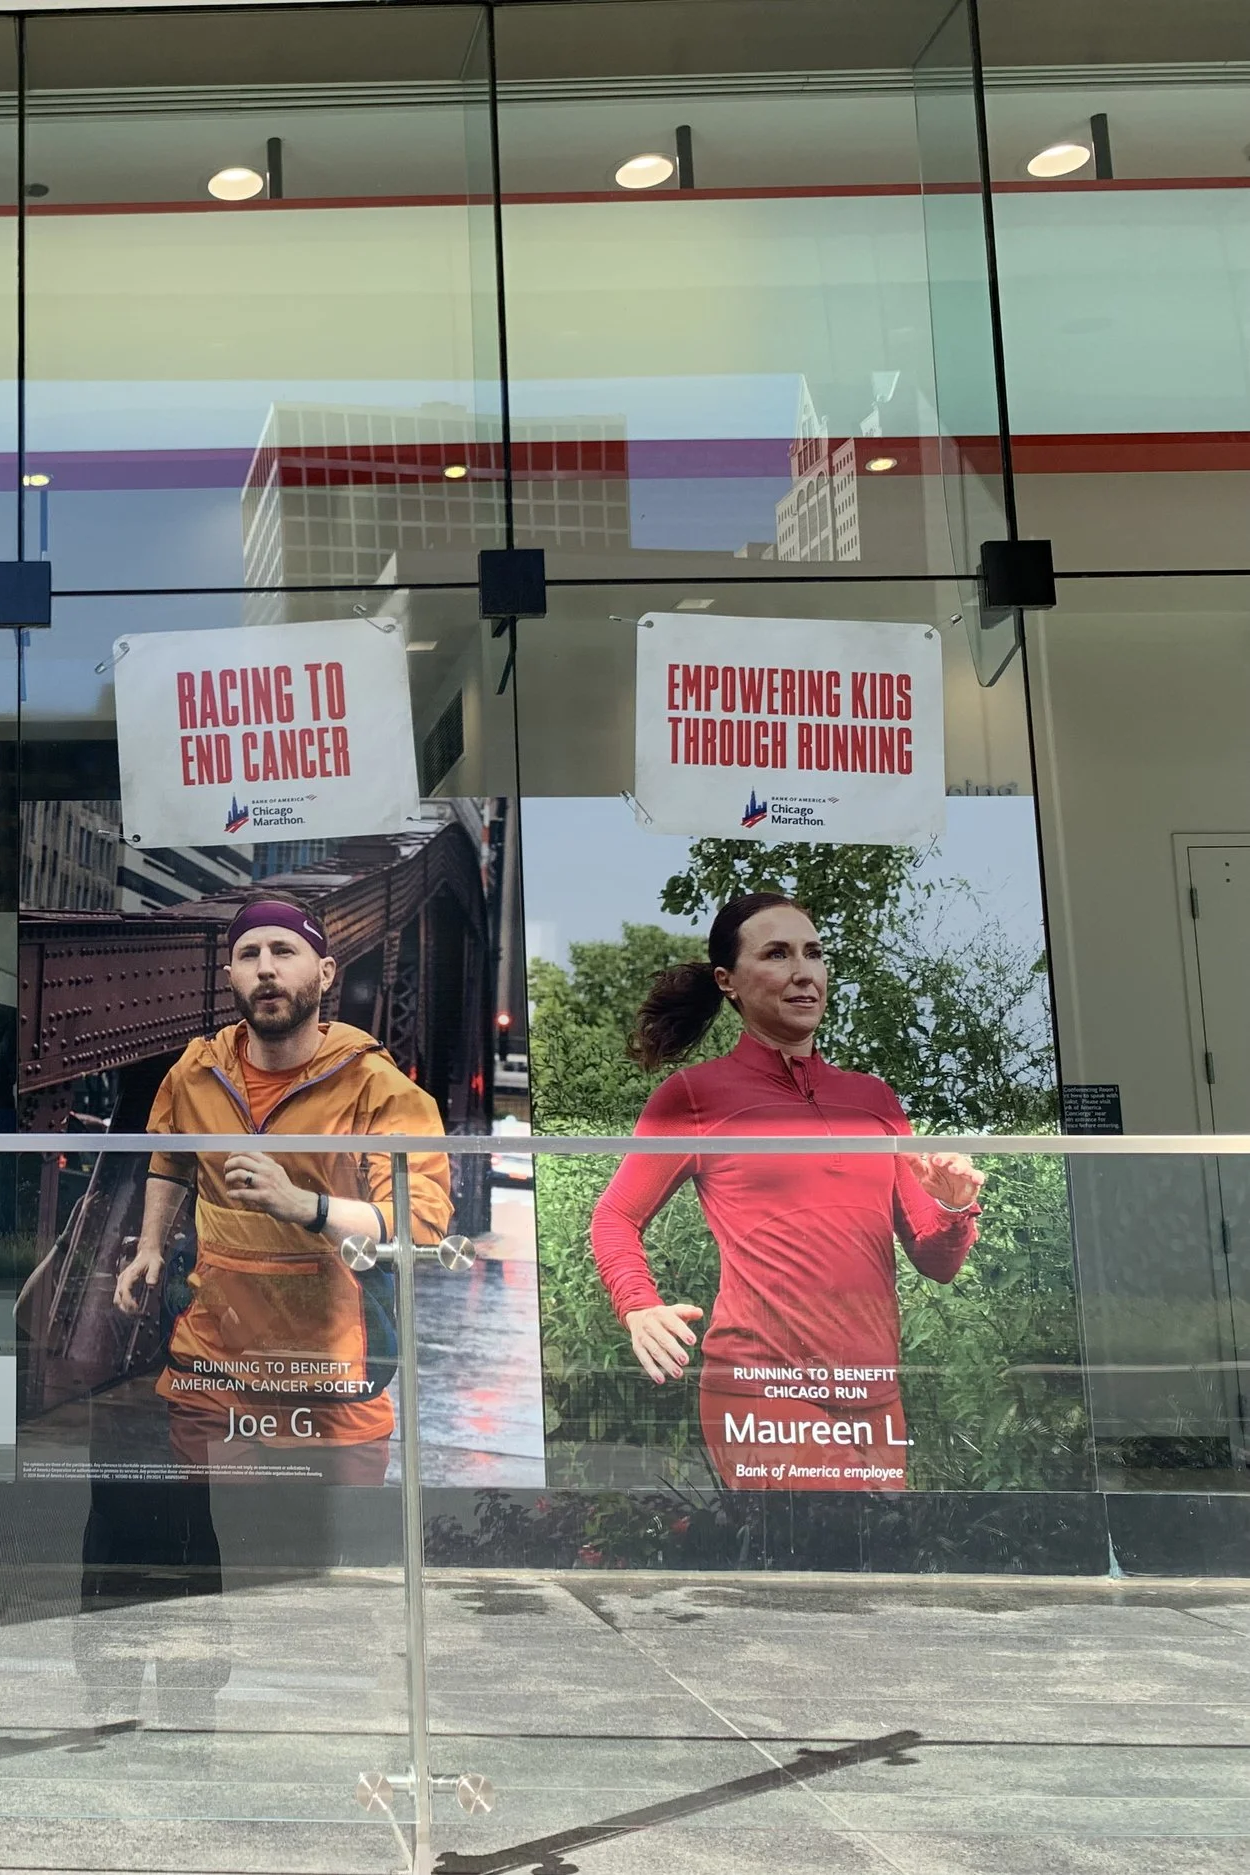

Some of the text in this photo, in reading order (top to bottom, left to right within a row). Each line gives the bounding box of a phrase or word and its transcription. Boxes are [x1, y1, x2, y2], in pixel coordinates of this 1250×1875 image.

[177, 662, 347, 730] RACING TO
[667, 663, 912, 721] EMPOWERING KIDS
[667, 717, 913, 775] THROUGH RUNNING
[180, 726, 351, 786] END CANCER
[252, 806, 293, 817] Chicago
[771, 804, 814, 817] Chicago
[193, 1360, 351, 1375] RUNNING TO BENEFIT
[734, 1367, 896, 1382] RUNNING TO BENEFIT
[170, 1378, 375, 1394] AMERICAN CANCER SOCIETY
[764, 1385, 868, 1399] CHICAGO RUN
[223, 1406, 322, 1443] Joe G.
[724, 1412, 915, 1446] Maureen L.
[736, 1464, 904, 1482] Bank of America employee
